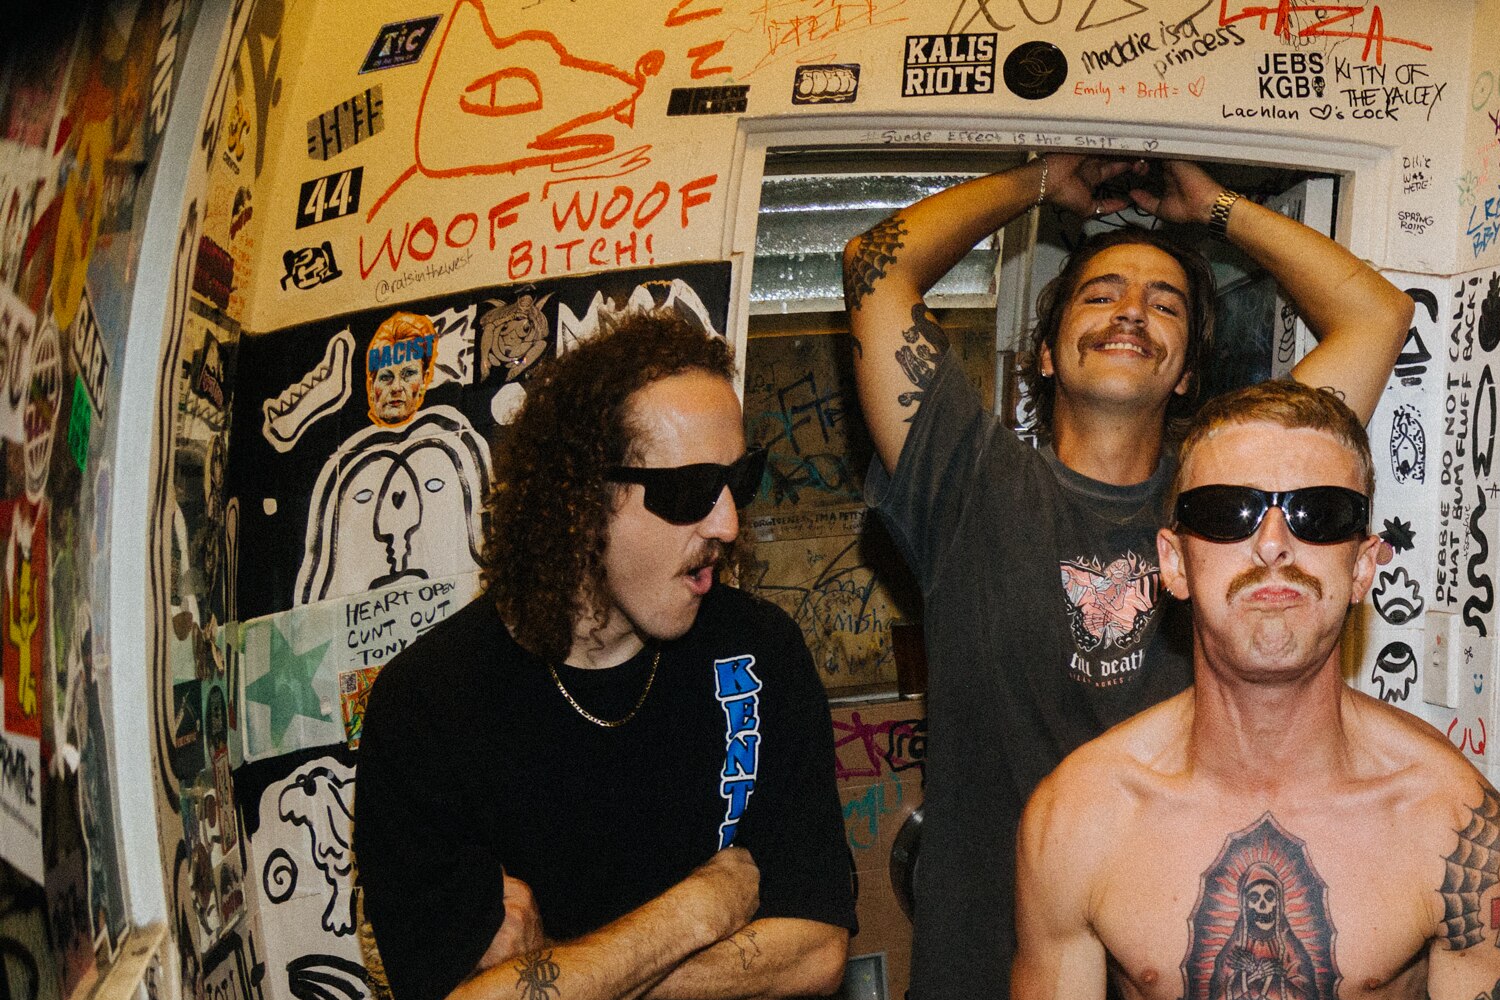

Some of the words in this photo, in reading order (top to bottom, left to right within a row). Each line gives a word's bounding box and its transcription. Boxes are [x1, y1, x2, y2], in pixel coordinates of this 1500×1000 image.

[907, 36, 996, 64] KALIS
[1153, 24, 1246, 79] princess
[1257, 53, 1324, 75] JEBS
[905, 65, 993, 95] RIOTS
[1258, 76, 1311, 99] KGB
[1395, 64, 1429, 85] OF
[1222, 104, 1299, 120] Lachlan
[1340, 87, 1381, 107] THE
[359, 191, 531, 279] WOOF
[552, 174, 718, 234] WOOF
[508, 234, 656, 280] BITCH!
[1448, 279, 1466, 364] CALL
[368, 333, 436, 372] RACIST
[1444, 372, 1460, 436] NOT
[1440, 449, 1453, 486] DO
[1451, 464, 1465, 520] BUM
[1434, 501, 1450, 602] DEBBIE
[1446, 531, 1461, 607] THAT
[346, 590, 414, 628] HEART
[418, 581, 456, 602] OPEN
[347, 618, 396, 649] CUNT
[409, 599, 451, 627] OUT
[1070, 652, 1093, 677] till
